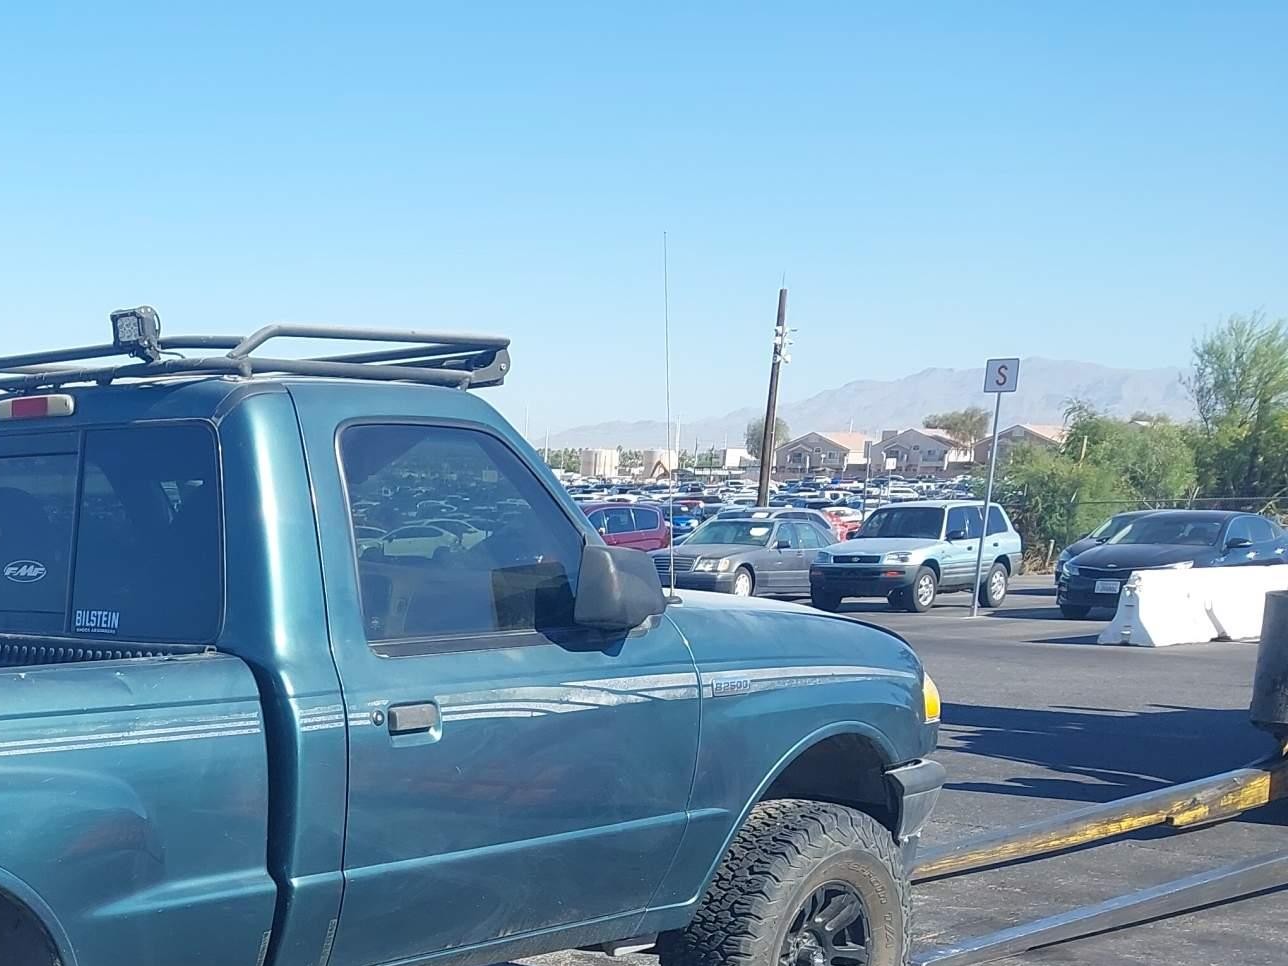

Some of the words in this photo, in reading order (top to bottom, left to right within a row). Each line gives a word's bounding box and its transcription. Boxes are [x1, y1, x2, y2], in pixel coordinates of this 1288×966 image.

[995, 365, 1008, 386] S
[75, 610, 120, 629] BILSTEIN
[715, 680, 749, 691] B2500
